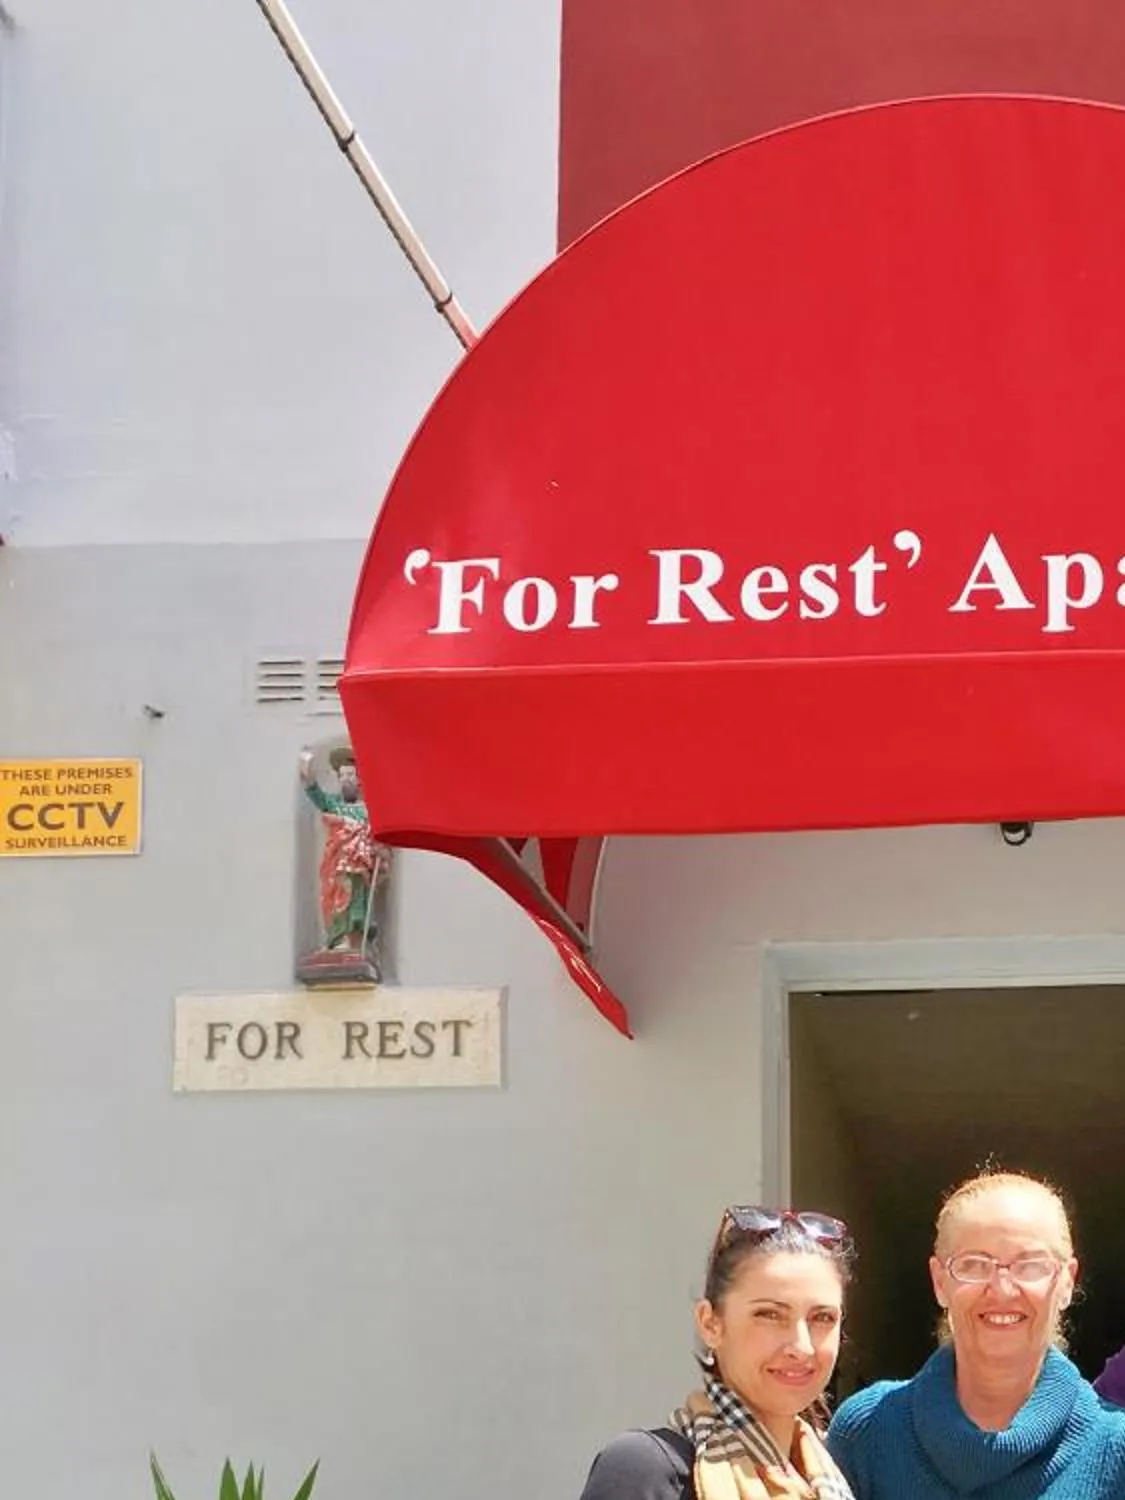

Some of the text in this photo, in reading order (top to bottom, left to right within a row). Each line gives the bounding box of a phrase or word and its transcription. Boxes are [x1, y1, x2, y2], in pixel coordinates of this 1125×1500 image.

[0, 767, 134, 781] THESE PREMISES
[19, 783, 113, 796] ARE UNDER
[7, 801, 125, 831] CCTV
[5, 835, 128, 850] SURVEILLANCE
[204, 1018, 473, 1061] FOR REST
